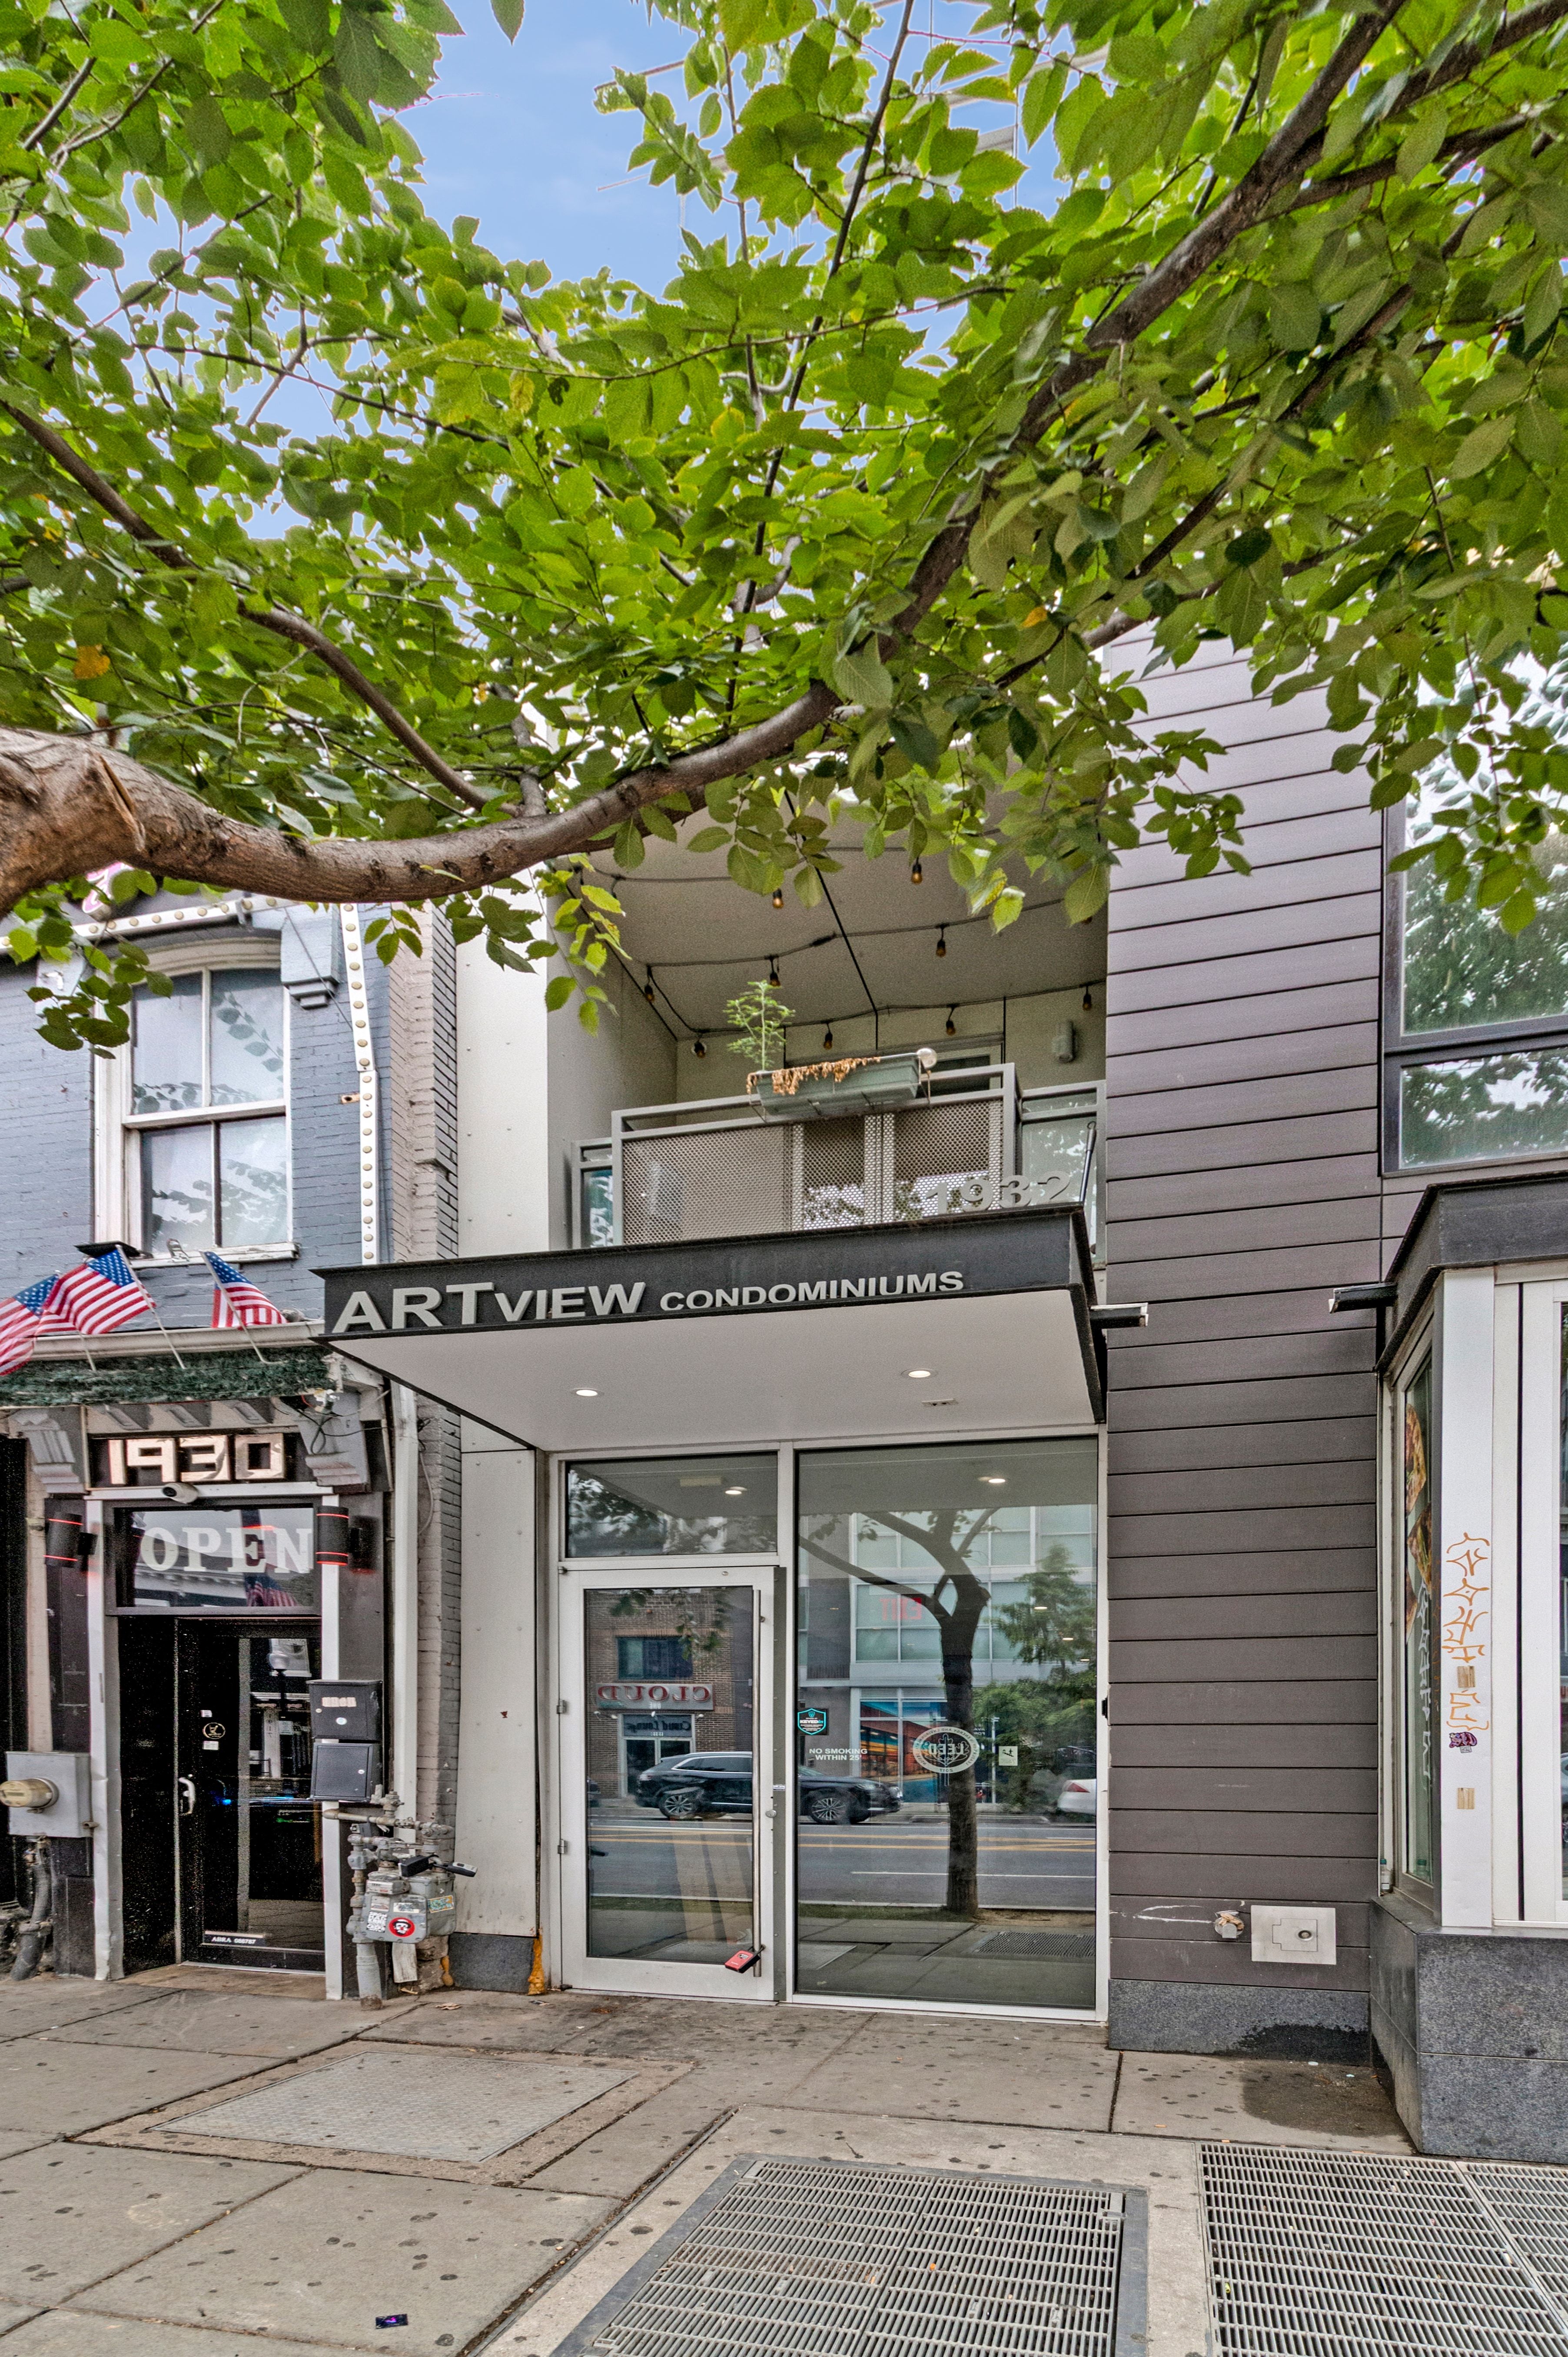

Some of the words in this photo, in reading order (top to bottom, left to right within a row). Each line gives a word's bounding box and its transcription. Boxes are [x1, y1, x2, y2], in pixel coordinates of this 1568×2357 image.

[925, 1170, 1071, 1214] 1932
[659, 1270, 964, 1311] CONDOMINIUMS
[109, 1433, 285, 1485] 1930
[140, 1526, 312, 1574] OPEN
